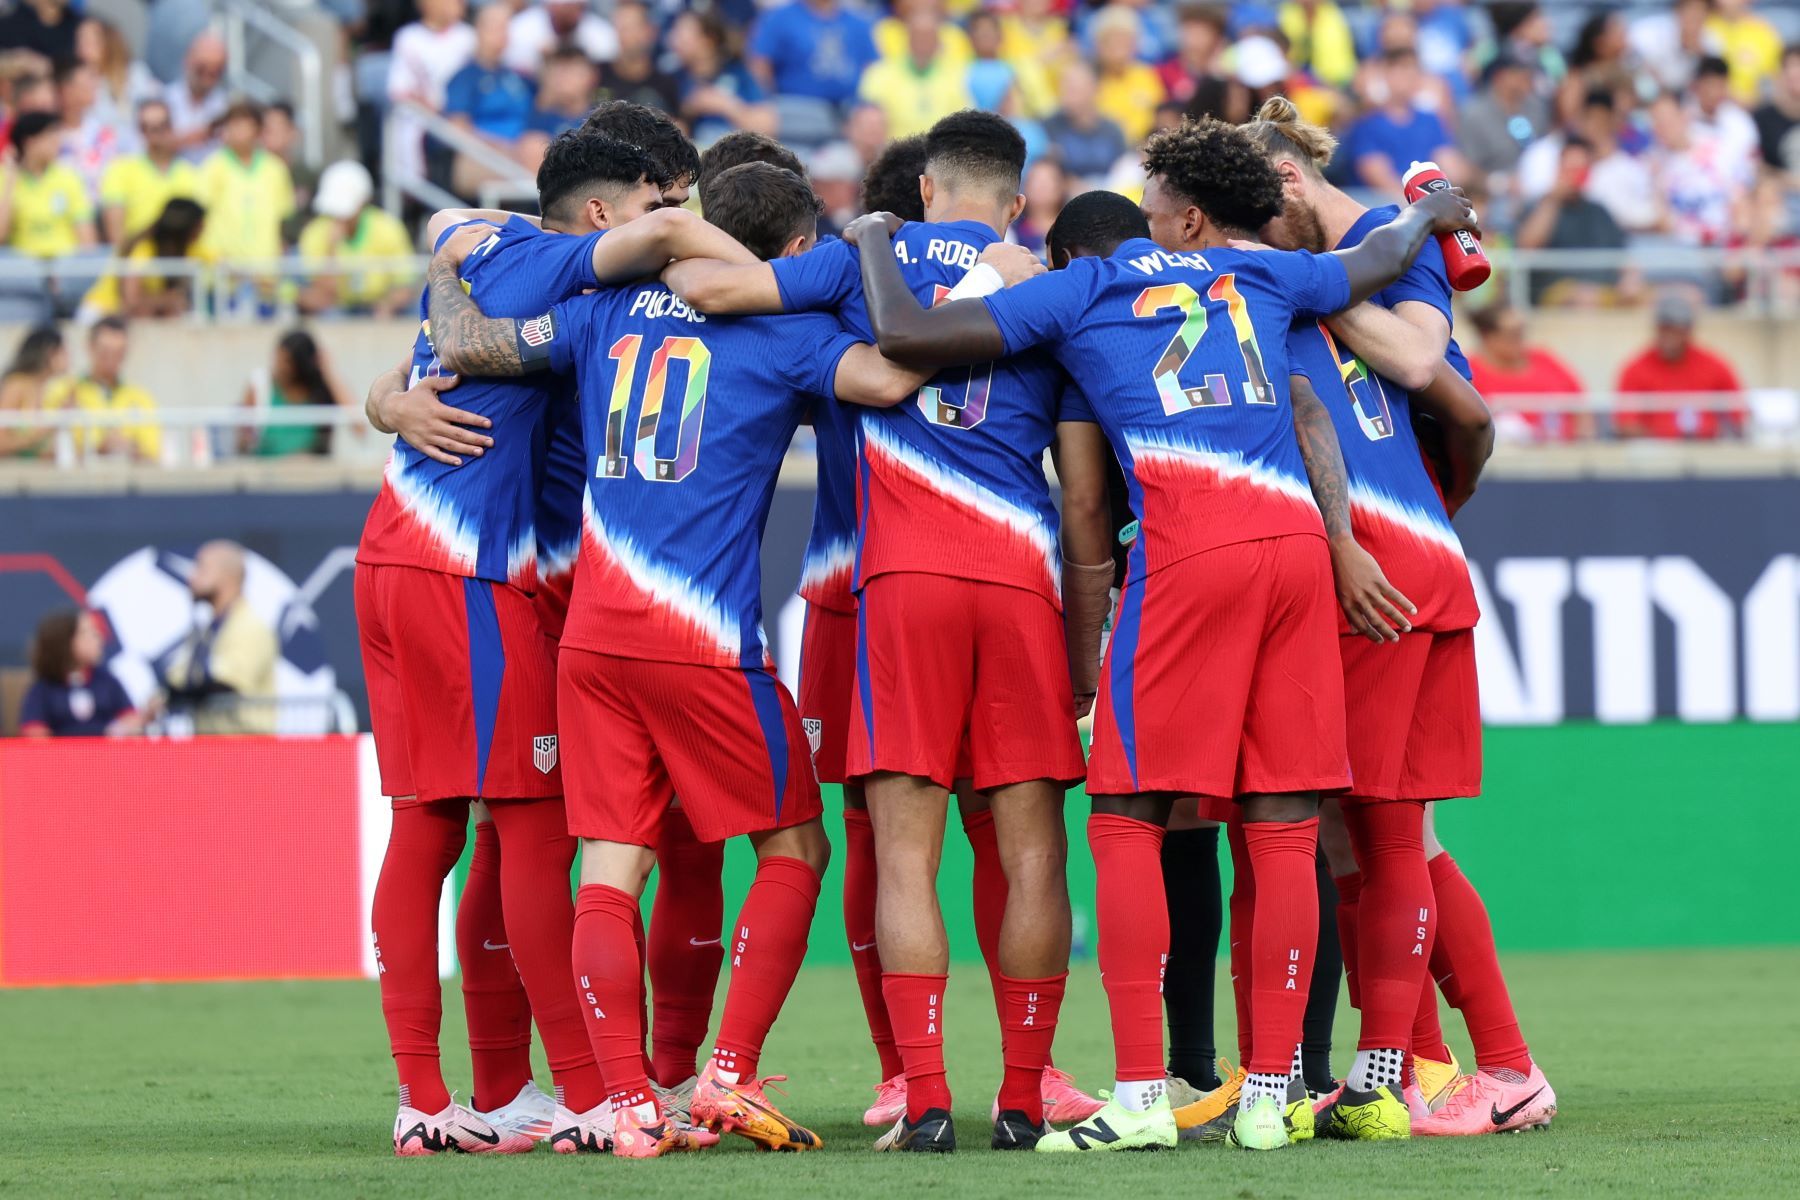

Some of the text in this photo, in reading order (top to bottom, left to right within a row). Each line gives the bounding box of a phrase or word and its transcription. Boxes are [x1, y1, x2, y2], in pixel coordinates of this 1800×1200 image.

[893, 238, 979, 271] A. ROB
[1131, 272, 1277, 417] 21
[595, 333, 712, 484] 10
[535, 736, 556, 752] USA
[803, 720, 820, 735] USA
[733, 925, 749, 968] USA
[1411, 907, 1428, 956] USA
[1285, 948, 1300, 990] USA
[580, 975, 606, 1019] USA
[927, 994, 937, 1035] USA
[1022, 992, 1038, 1026] USA
